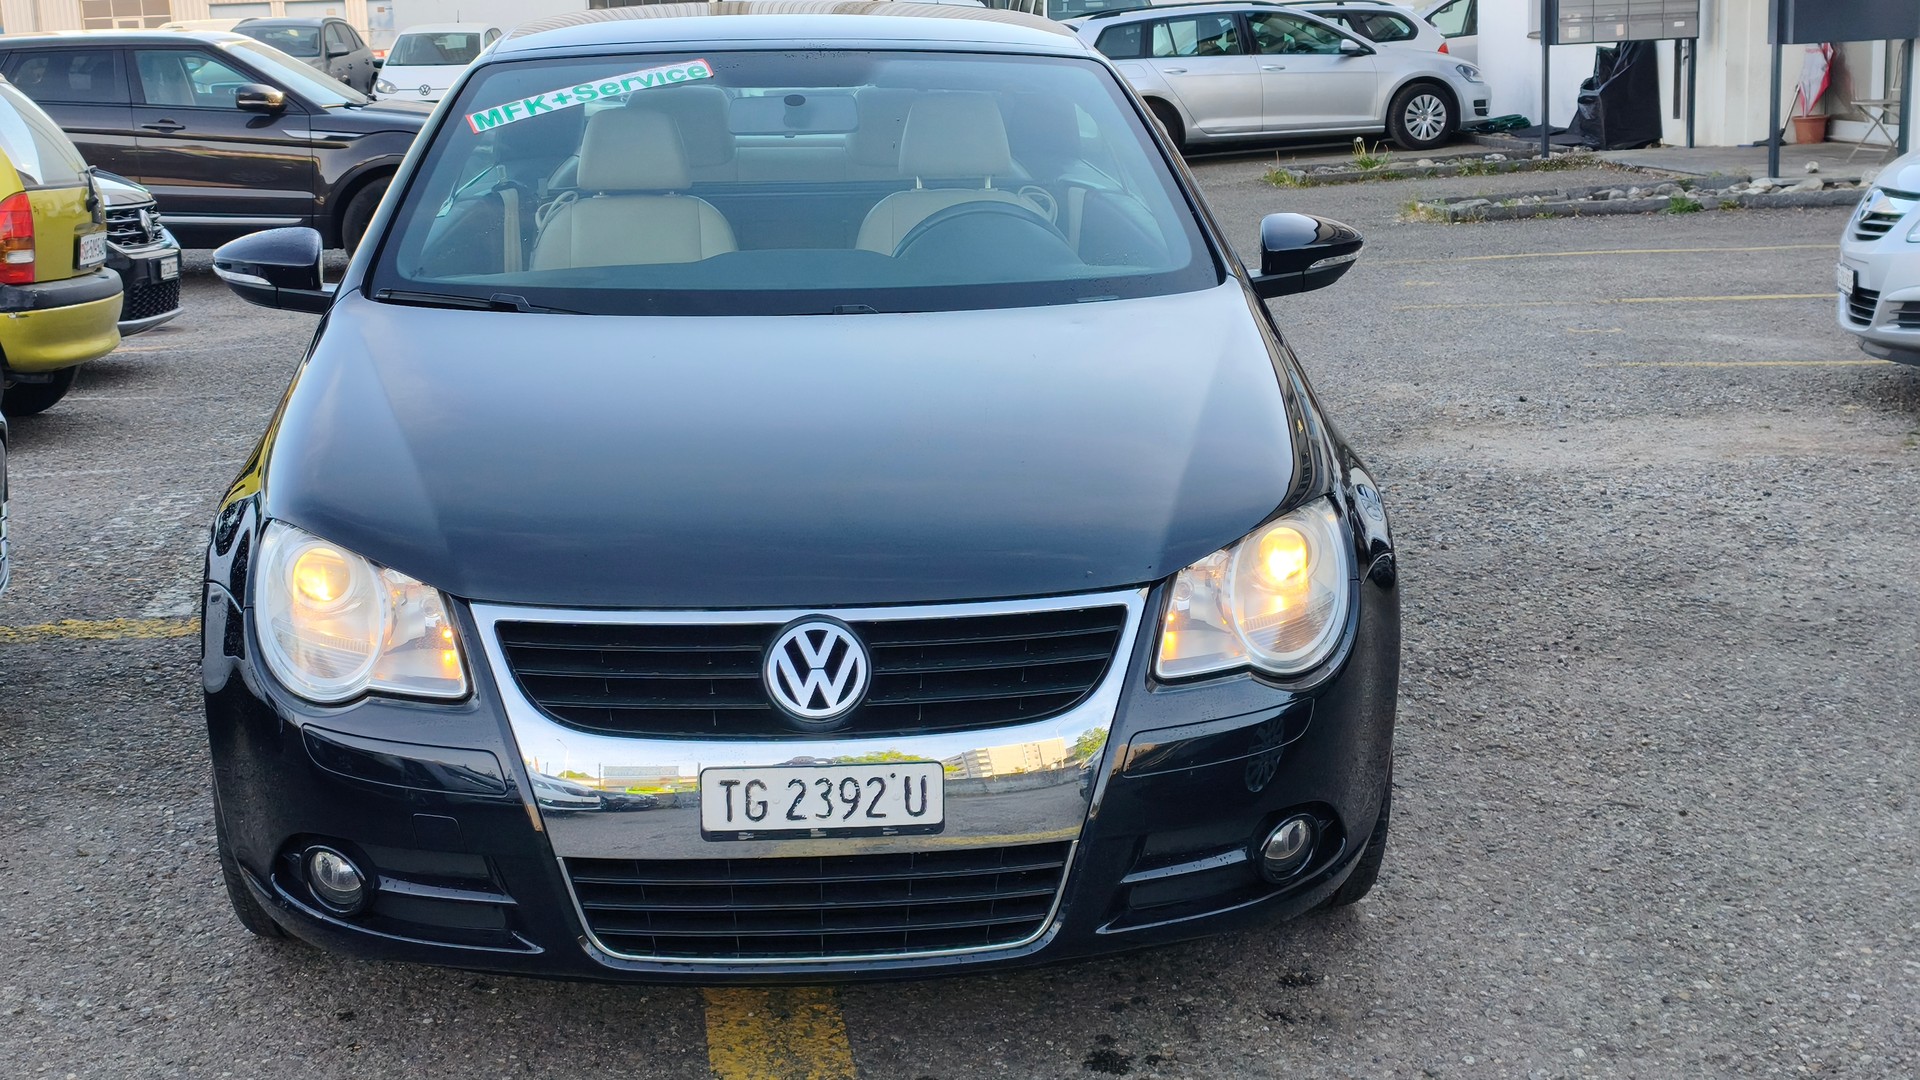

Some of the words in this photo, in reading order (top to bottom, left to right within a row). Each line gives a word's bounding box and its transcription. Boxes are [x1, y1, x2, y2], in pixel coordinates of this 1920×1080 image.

[770, 624, 865, 715] VW
[719, 778, 769, 823] TG
[904, 774, 928, 818] U
